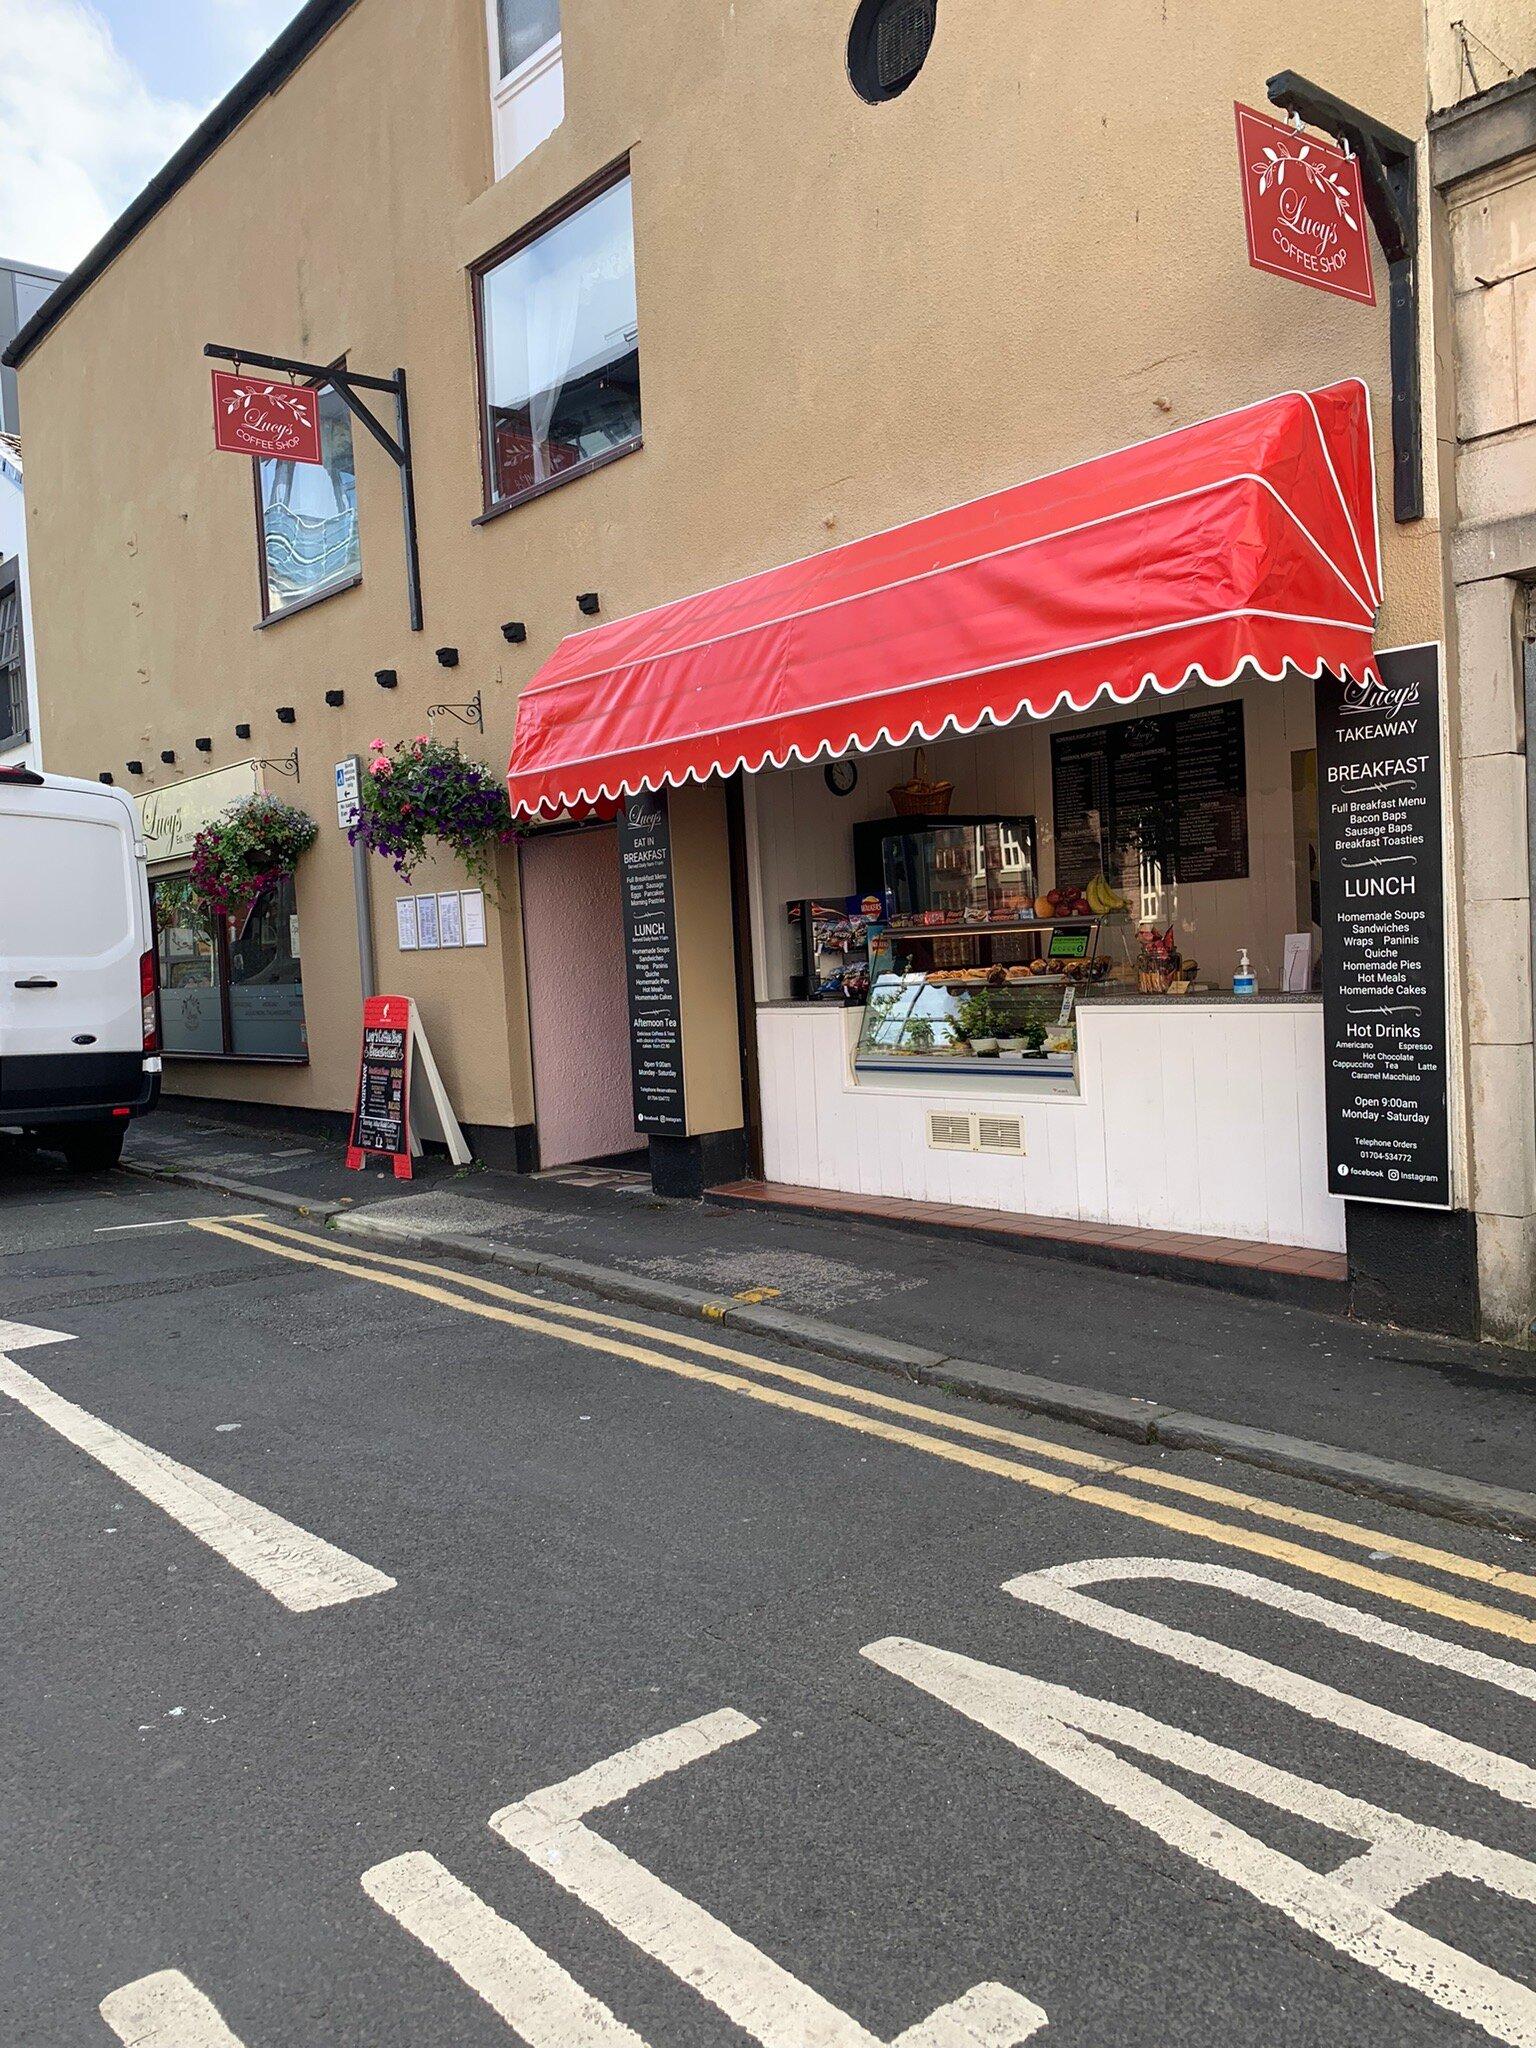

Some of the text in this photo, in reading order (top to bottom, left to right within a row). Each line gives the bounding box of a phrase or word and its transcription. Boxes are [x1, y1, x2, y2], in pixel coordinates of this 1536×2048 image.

[1276, 188, 1338, 256] Lucy's
[1272, 228, 1348, 273] COFFEE SHOP
[242, 408, 293, 442] Lucy's
[236, 428, 300, 450] COFFEE SHOP
[1338, 680, 1420, 720] Lucy's
[1336, 719, 1418, 743] TAKEAWAY
[1328, 756, 1430, 782] BREAKFAST
[1332, 796, 1426, 814] Full Breakfast Menu
[142, 794, 182, 854] Lucy's
[628, 804, 662, 832] Lucy's
[1350, 810, 1407, 824] Bacon Baps
[1344, 822, 1413, 838] Sausage Baps
[634, 837, 654, 848] EAT IN
[1335, 834, 1424, 850] Breakfast Toasties
[624, 848, 666, 864] BREAKFAST
[1344, 876, 1416, 898] LUNCH
[1338, 910, 1426, 922] Homemade Soups
[634, 923, 665, 936] LUNCH
[1352, 922, 1410, 934] Sandwiches
[1344, 934, 1420, 947] Wraps Paninis
[1364, 948, 1398, 958] Quiche
[1343, 960, 1422, 971] Homemade Pies
[1358, 972, 1406, 983] Hot Meals
[1340, 984, 1426, 996] Homemade Cakes
[634, 1018, 677, 1027] Afternoon Tea
[1346, 1024, 1421, 1038] Hot Drinks
[1336, 1041, 1433, 1052] Americano Espresso
[1362, 1052, 1414, 1062] Hot Chocolate
[1332, 1060, 1438, 1072] Cappuccino Tea Latte
[1351, 1072, 1420, 1082] Caramel Macchiato
[1354, 1096, 1418, 1108] Open 9:00am
[1342, 1109, 1379, 1122] Monday
[1386, 1112, 1430, 1125] Saturday
[1354, 1137, 1418, 1150] Telephone Orders
[1350, 1167, 1438, 1182] facebook Instagram
